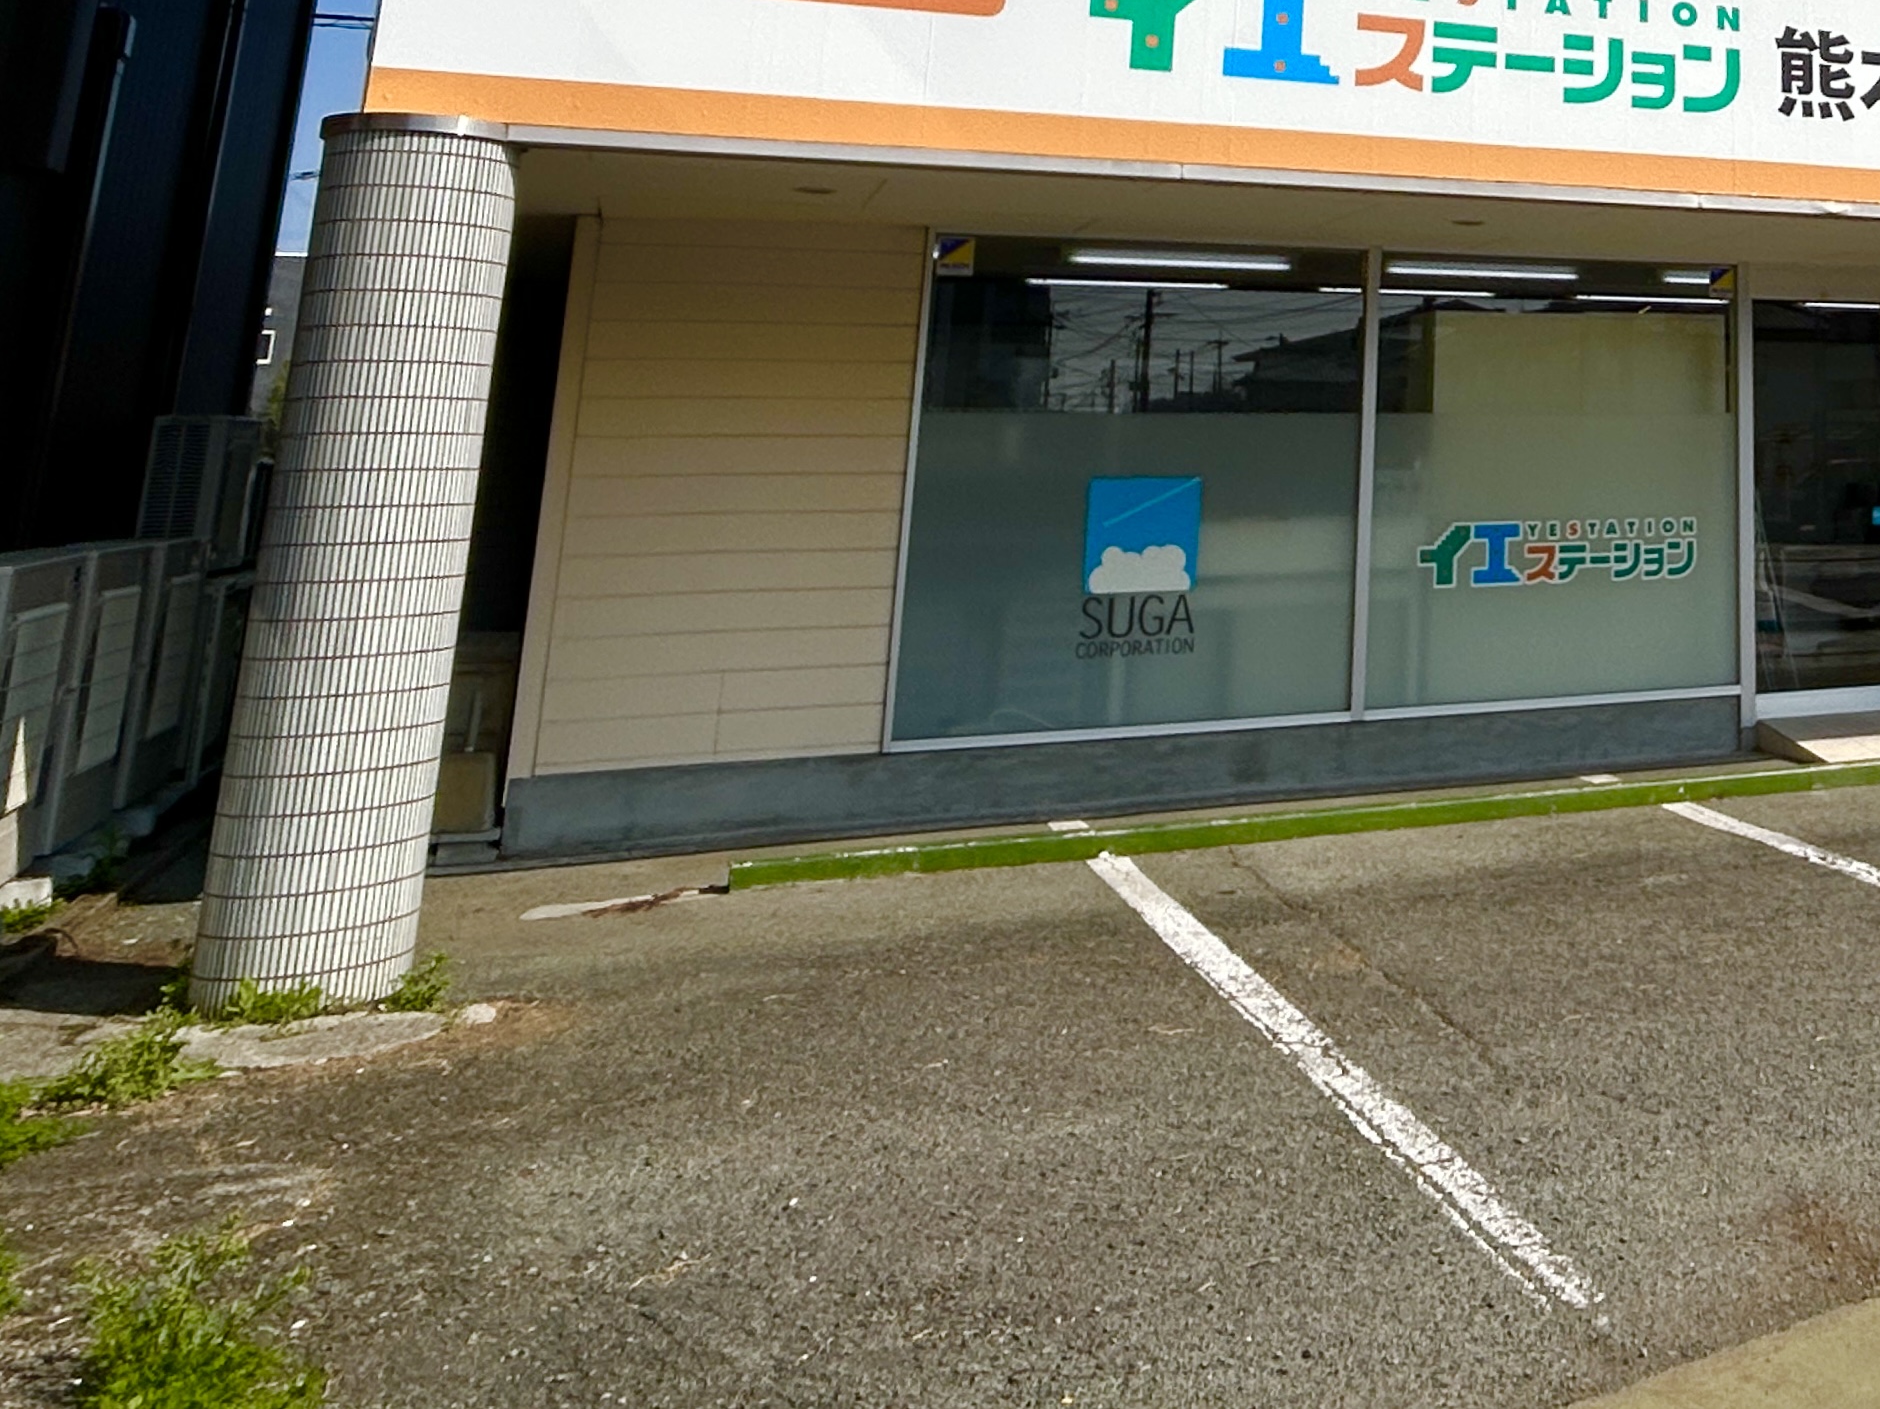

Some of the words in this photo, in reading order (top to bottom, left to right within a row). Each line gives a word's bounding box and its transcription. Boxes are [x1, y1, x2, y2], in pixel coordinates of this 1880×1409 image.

[1526, 518, 1696, 540] YESTATION
[1079, 593, 1195, 639] SUGA
[1075, 637, 1196, 660] CORPORATION
